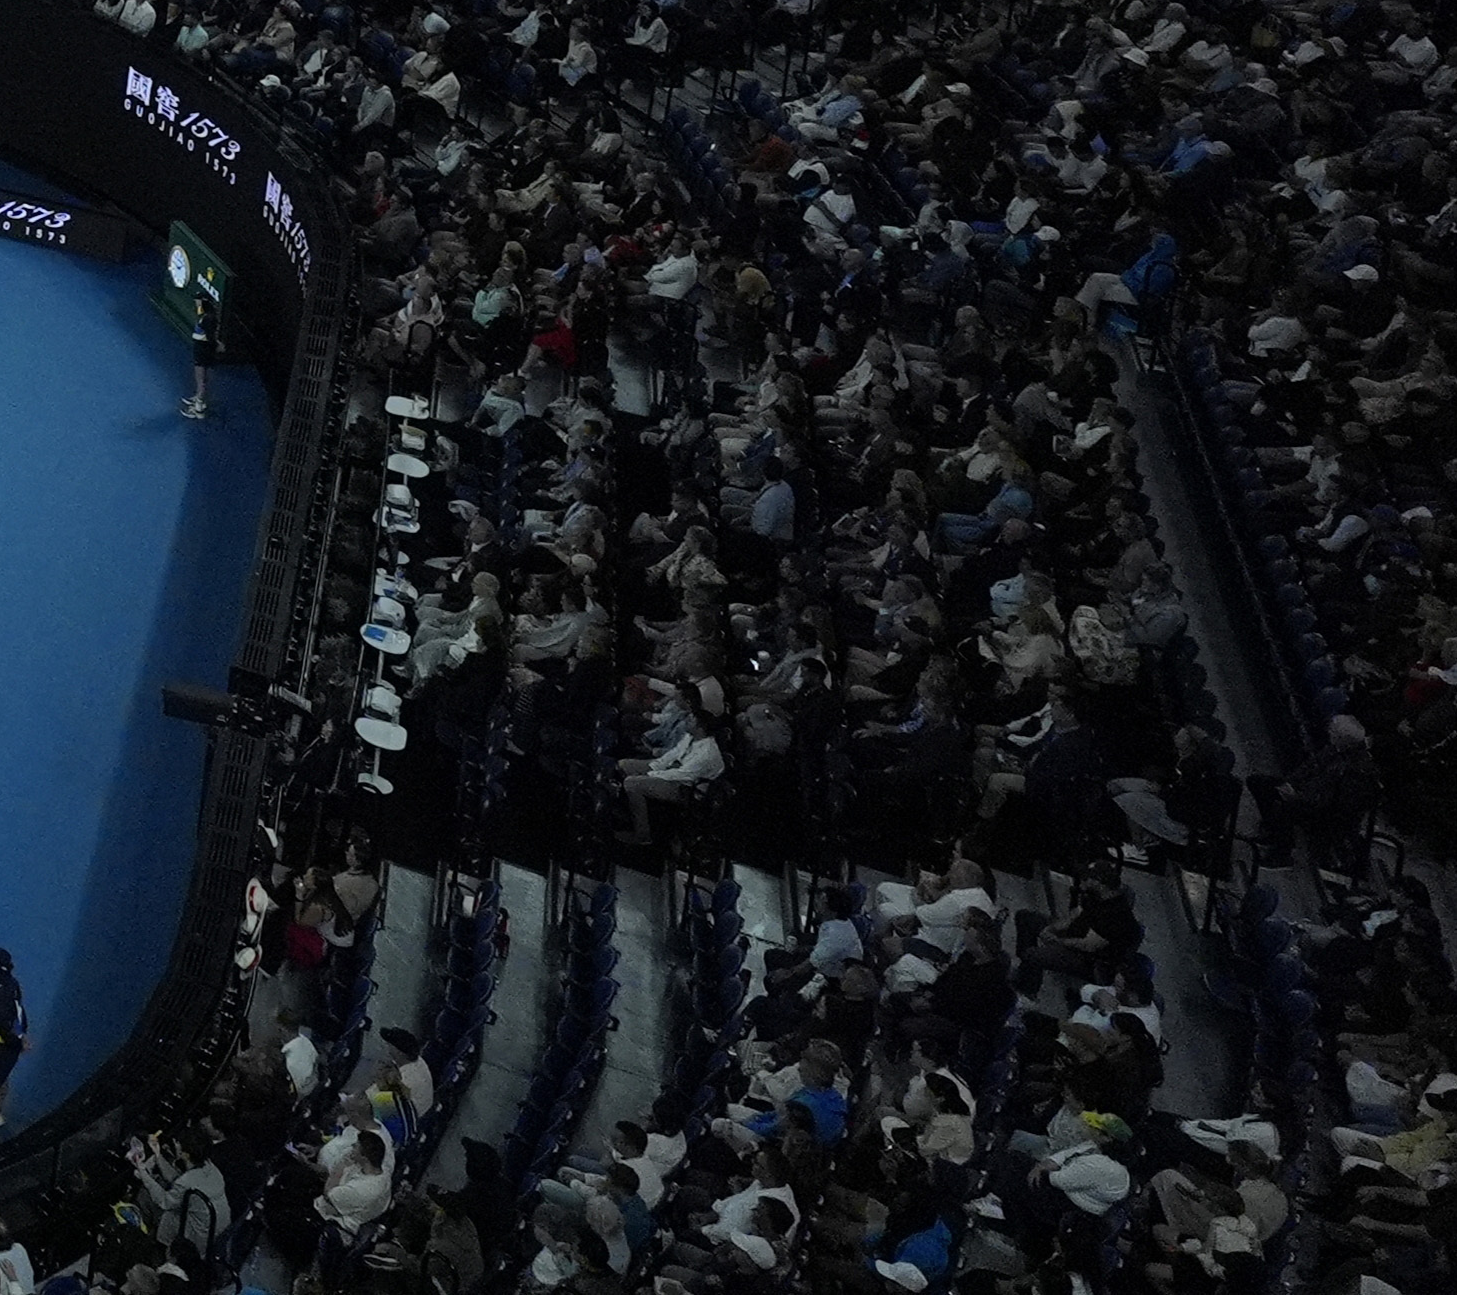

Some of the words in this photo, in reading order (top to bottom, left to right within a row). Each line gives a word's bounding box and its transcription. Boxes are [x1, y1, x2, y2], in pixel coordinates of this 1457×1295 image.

[124, 98, 194, 151] GUOJIAO
[206, 152, 236, 185] 1573
[25, 226, 66, 244] 1573
[197, 273, 219, 302] ROLEX
